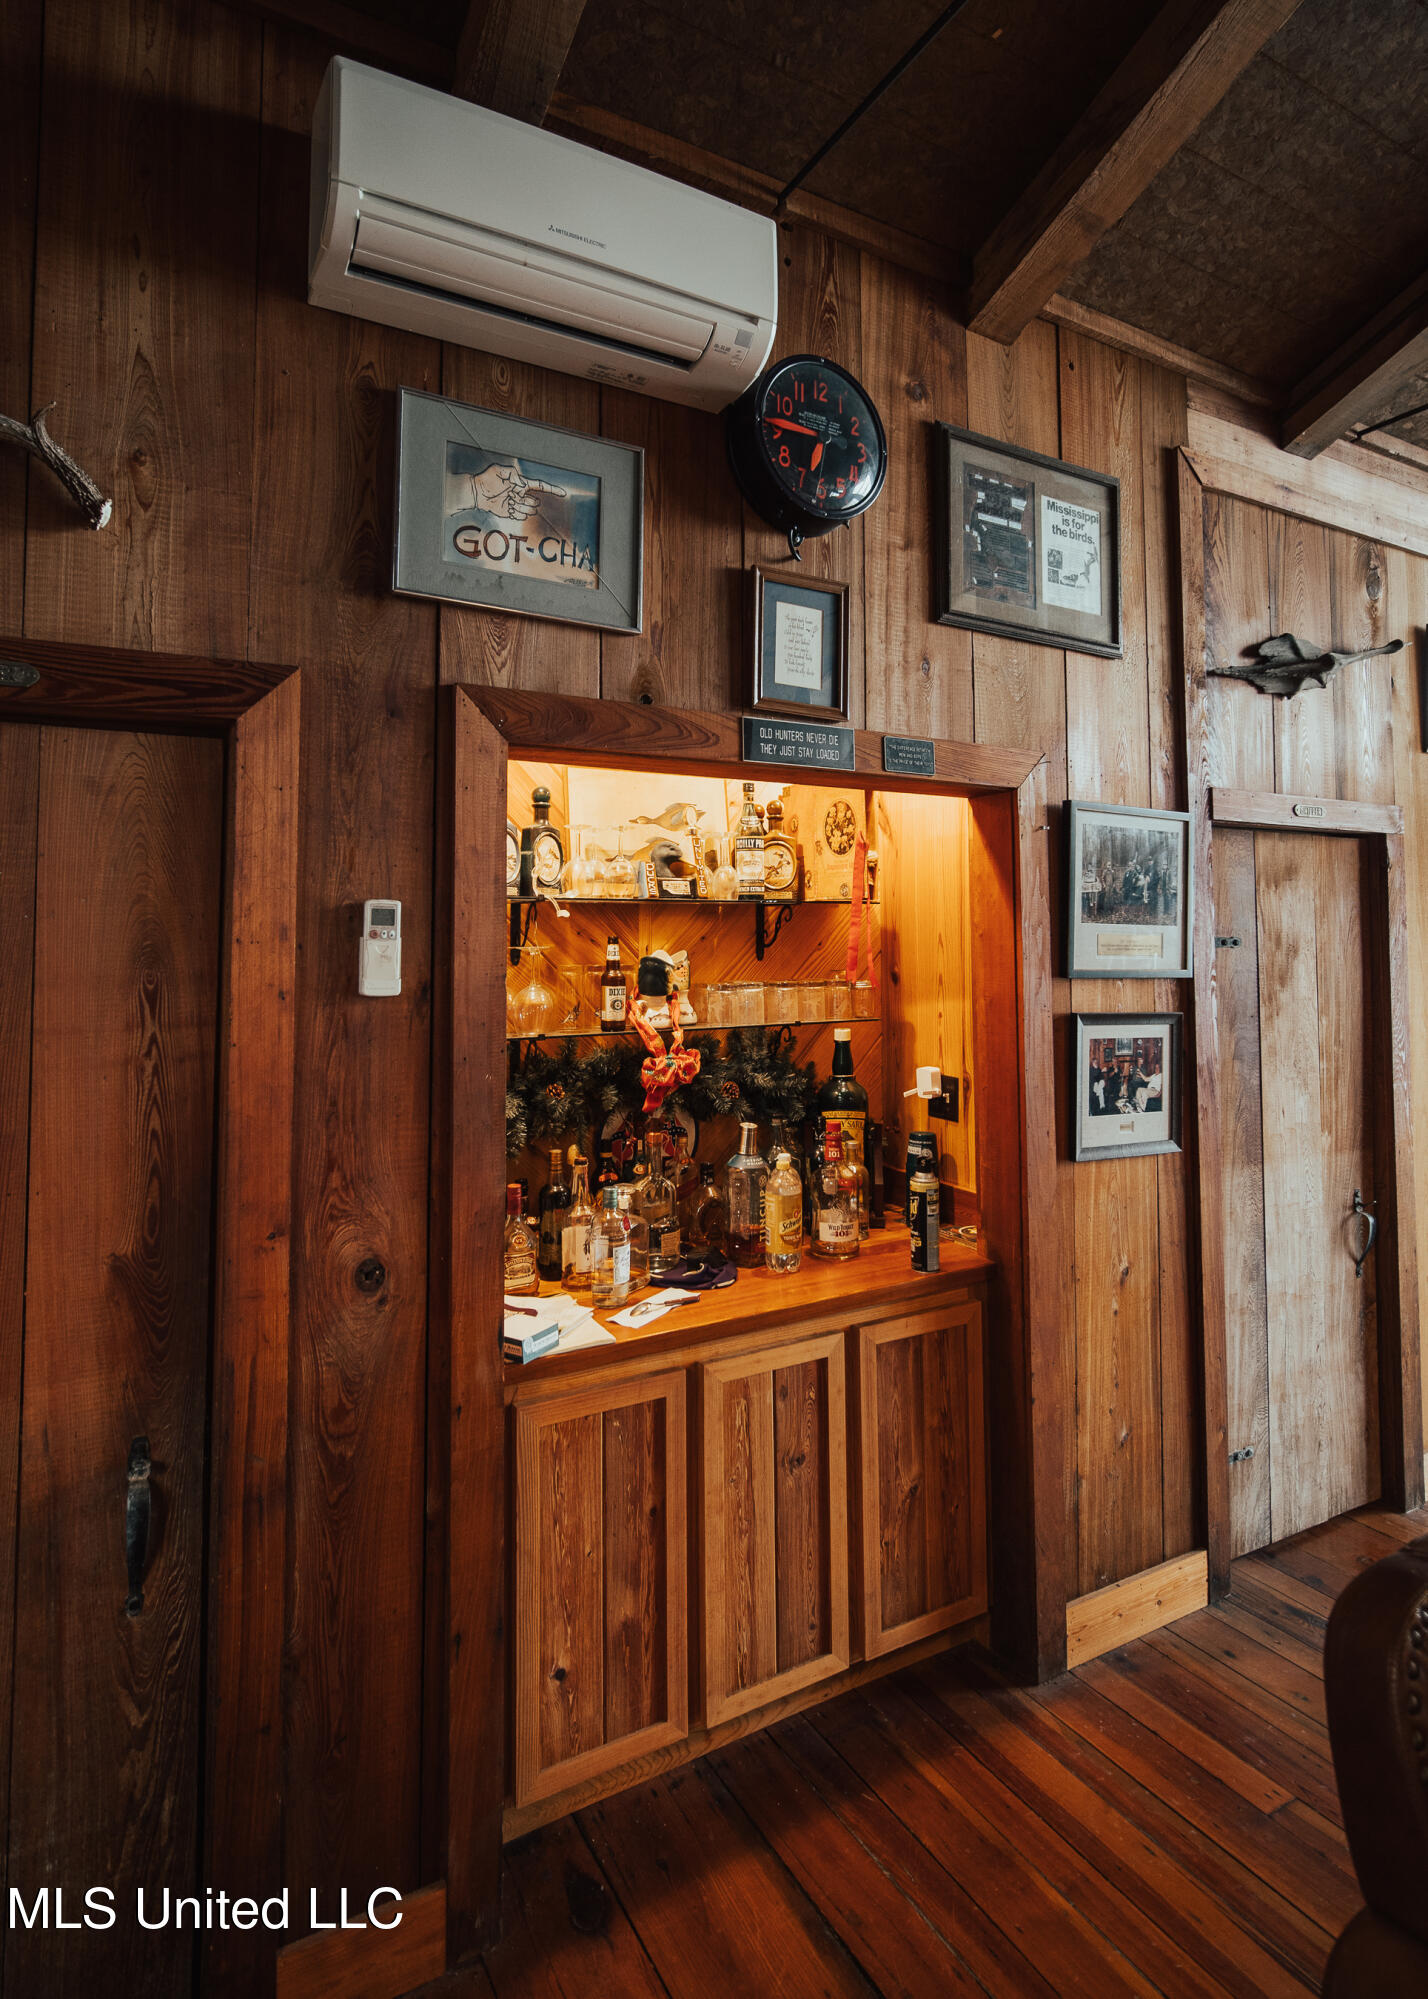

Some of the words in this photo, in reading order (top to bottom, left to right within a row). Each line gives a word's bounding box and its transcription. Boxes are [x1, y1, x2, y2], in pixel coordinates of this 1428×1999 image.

[795, 380, 804, 403] 11
[814, 380, 828, 402] 12
[777, 393, 793, 415] 10
[851, 416, 860, 436] 2
[779, 445, 791, 467] 8
[857, 442, 867, 463] 3
[798, 467, 806, 488] 7
[849, 464, 858, 485] 4
[816, 478, 827, 499] 6
[836, 477, 847, 498] 5
[1047, 500, 1099, 525] Mississippi
[1062, 515, 1070, 527] is
[1071, 518, 1085, 531] for
[1052, 524, 1068, 538] the
[1069, 528, 1095, 544] birds.
[453, 525, 594, 573] GOT-CHA
[759, 727, 773, 739] OLD
[775, 729, 804, 742] HUNTERS
[806, 732, 827, 745] NEVER
[829, 735, 839, 746] DIE
[760, 743, 777, 755] THEY
[780, 745, 795, 757] JUST
[798, 747, 814, 759] STAY
[816, 748, 840, 761] LOADED
